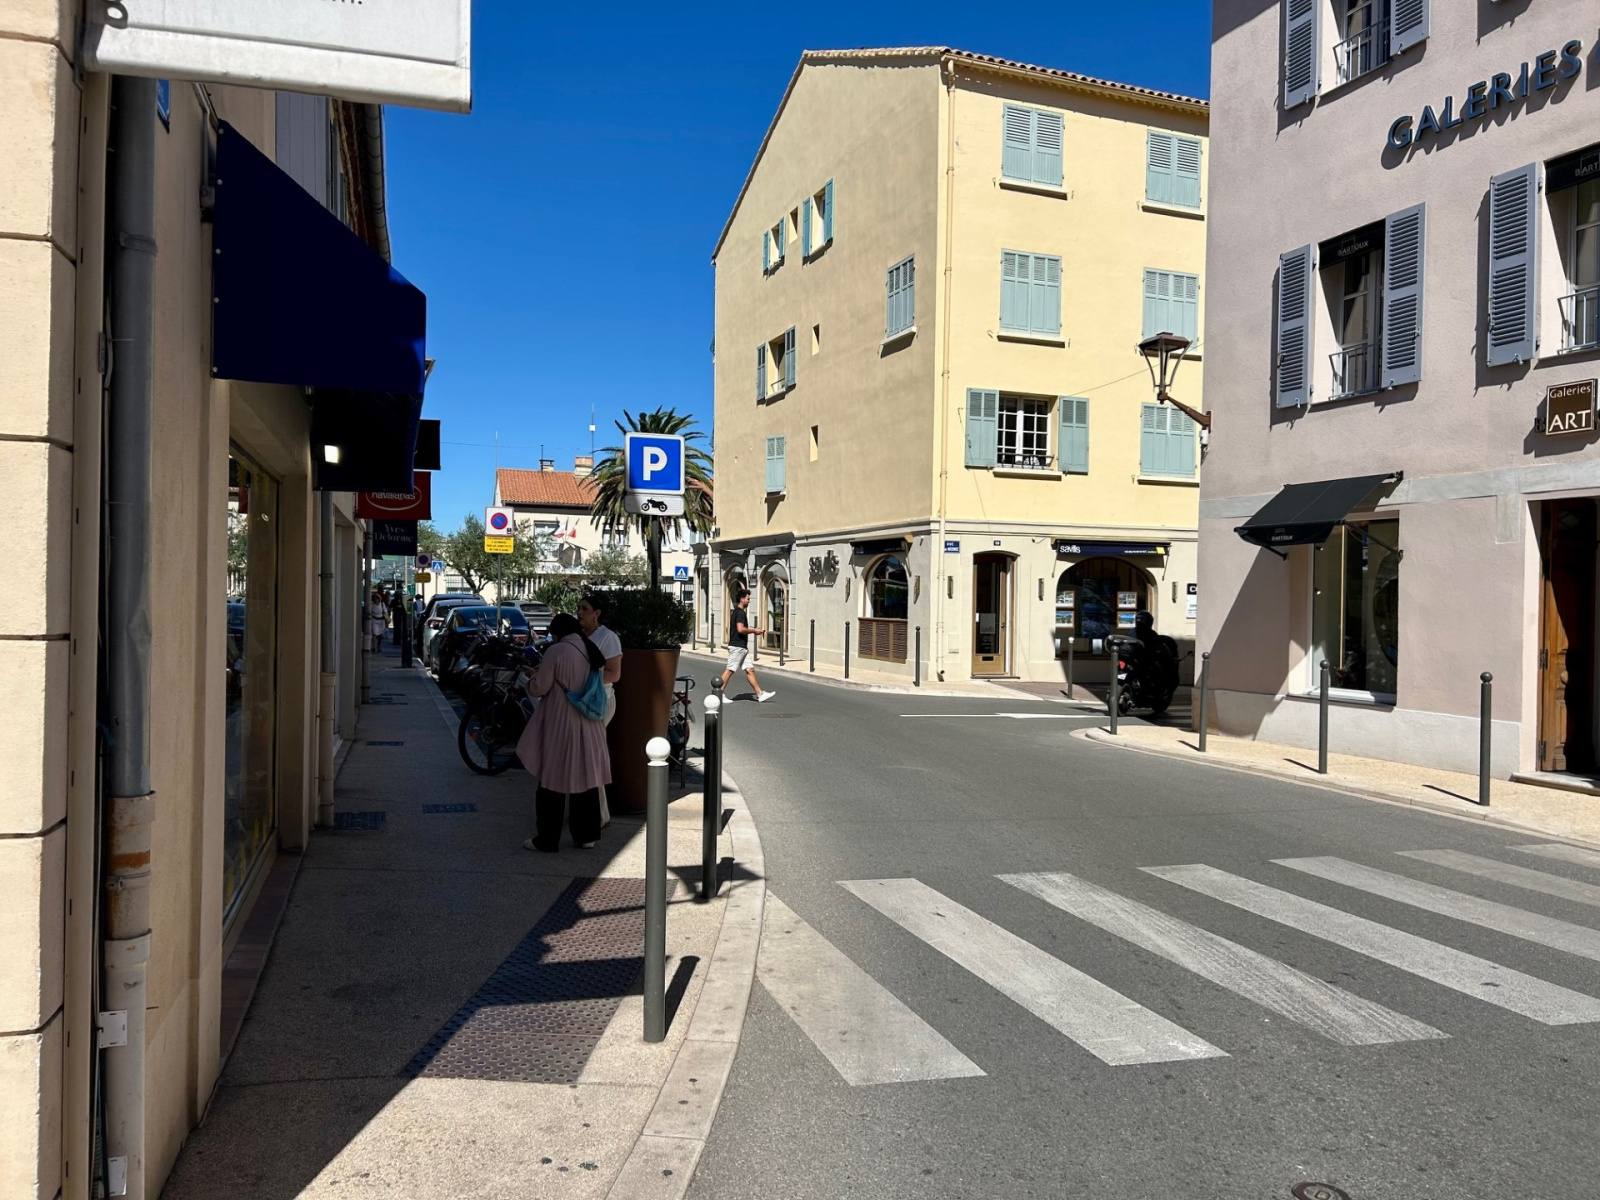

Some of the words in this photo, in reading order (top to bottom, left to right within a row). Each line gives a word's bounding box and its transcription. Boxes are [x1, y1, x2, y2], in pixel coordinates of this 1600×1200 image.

[1387, 39, 1584, 150] GALERIES
[1549, 385, 1591, 399] Galeries
[643, 446, 668, 481] P
[384, 523, 405, 533] Yves
[374, 532, 414, 543] Delorme
